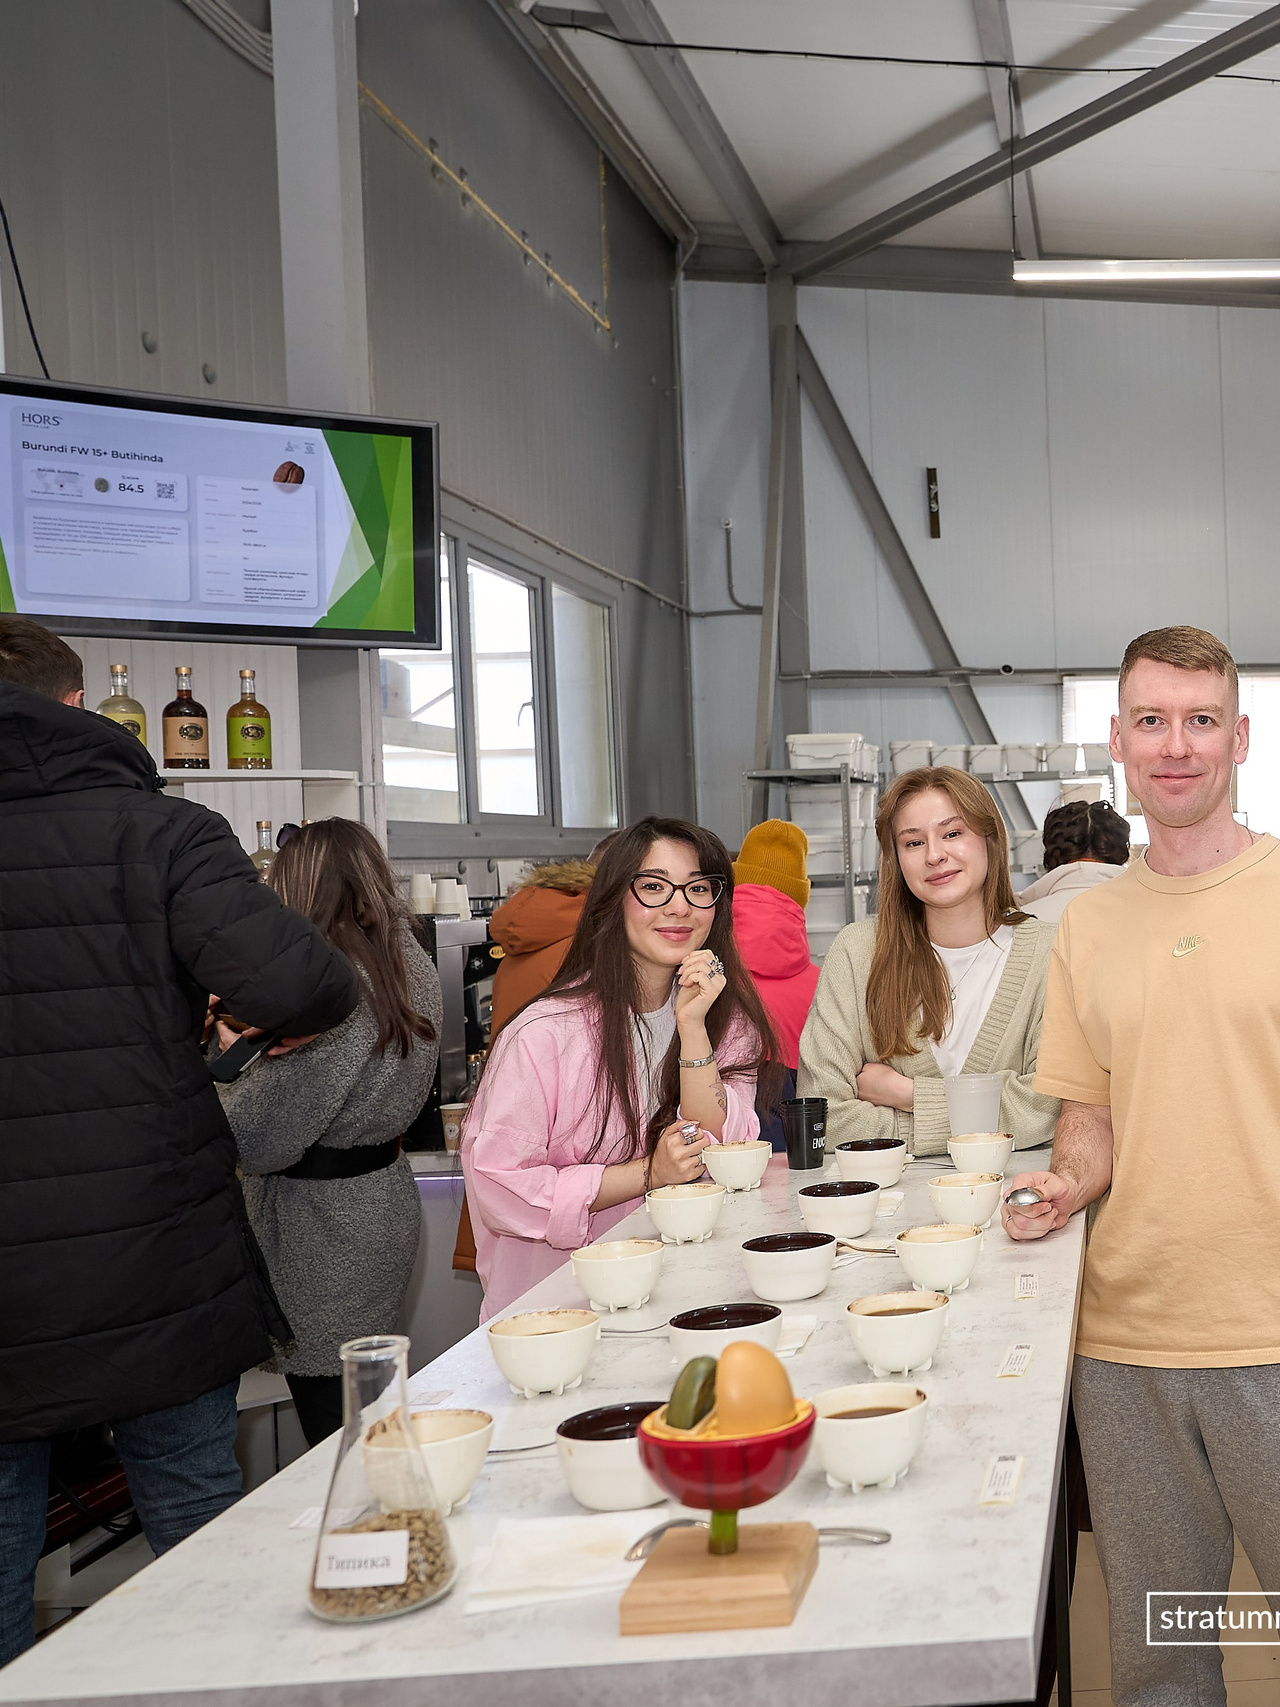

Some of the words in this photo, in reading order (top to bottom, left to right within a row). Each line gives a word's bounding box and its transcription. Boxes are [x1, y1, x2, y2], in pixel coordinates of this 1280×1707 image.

[22, 412, 60, 427] HORS
[22, 441, 68, 454] Burundi
[70, 446, 89, 456] FW
[92, 448, 108, 457] 15+
[111, 450, 164, 463] Butihinda
[118, 483, 144, 494] 84.5
[1178, 934, 1200, 949] NIKE
[327, 1555, 392, 1571] Типика
